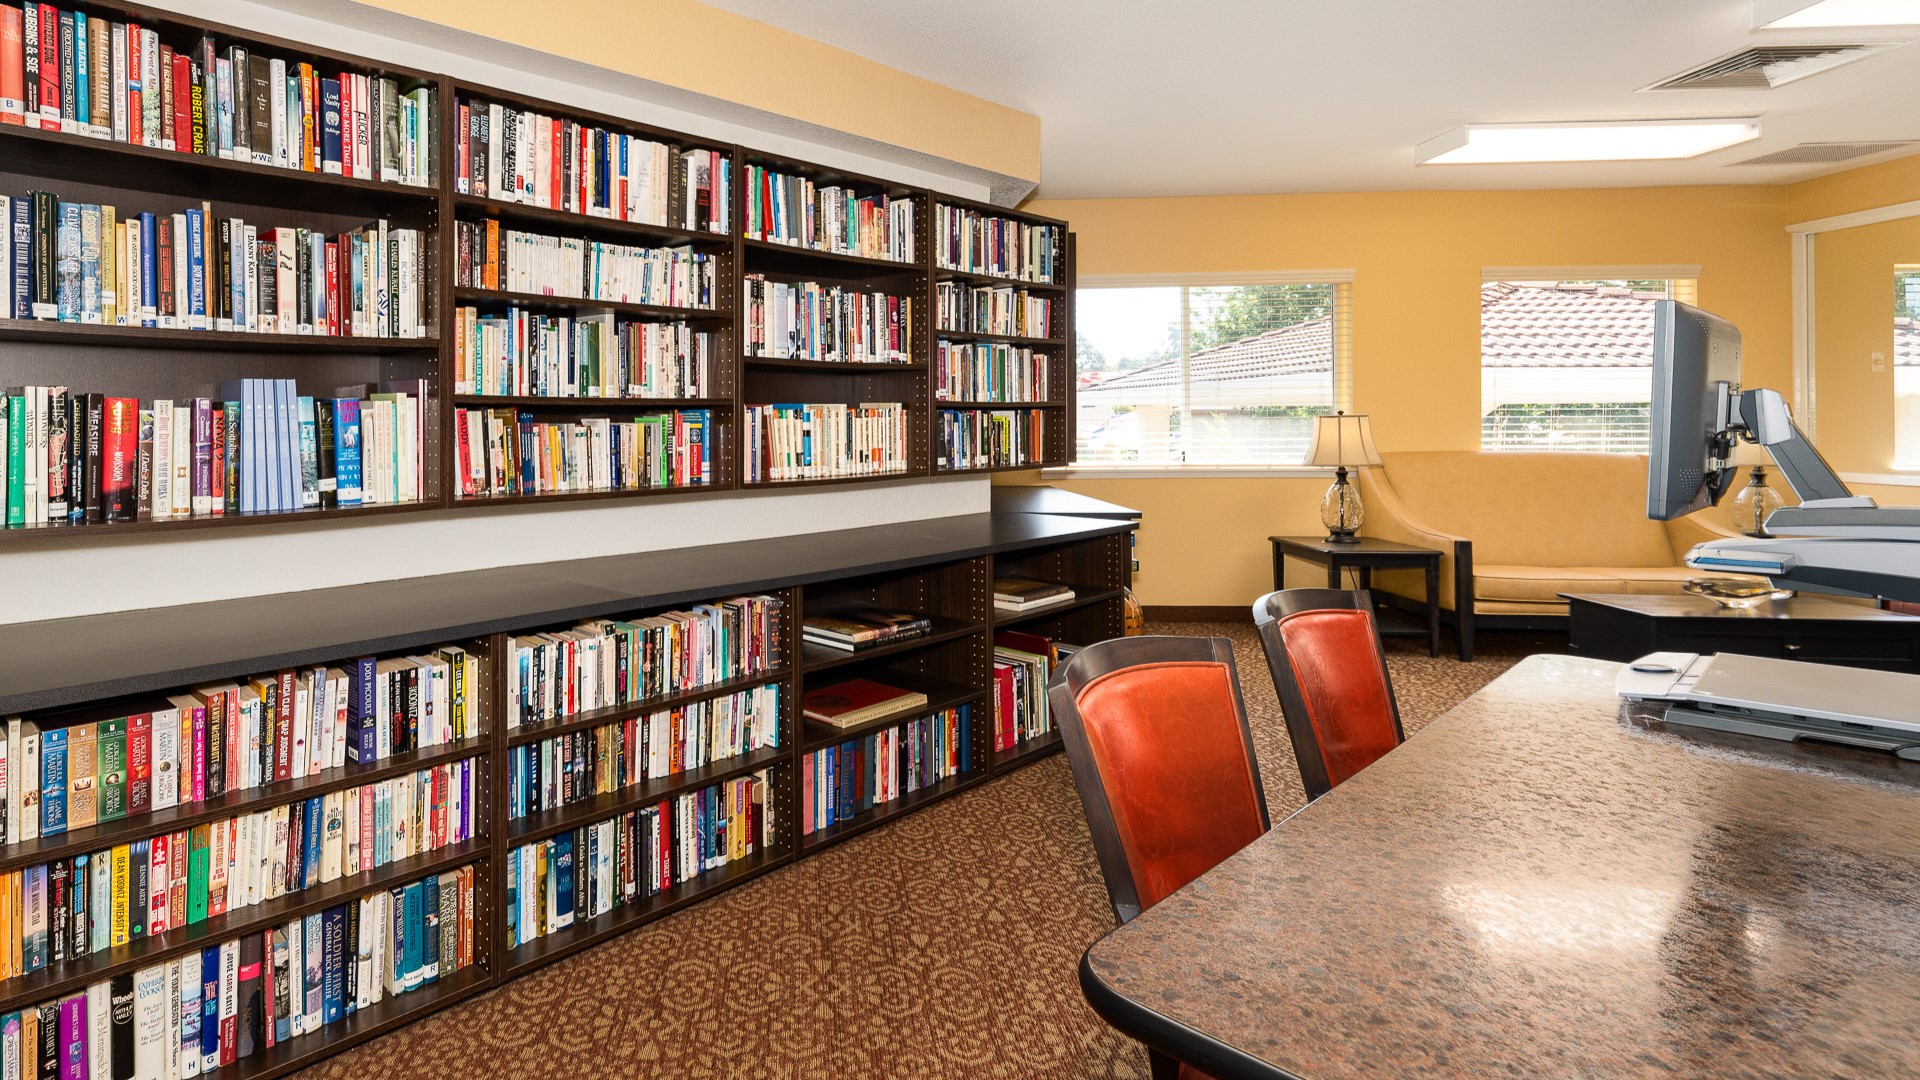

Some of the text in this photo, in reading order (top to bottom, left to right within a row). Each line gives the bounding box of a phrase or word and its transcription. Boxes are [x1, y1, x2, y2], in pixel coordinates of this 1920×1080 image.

[64, 28, 73, 57] AROUND
[78, 39, 86, 75] AVIATOR
[65, 64, 73, 89] WORLD
[6, 99, 14, 108] B
[65, 94, 73, 103] 80
[191, 85, 204, 154] ROBERT CRAIS
[342, 100, 352, 167] ONE MORE TIME!
[353, 110, 368, 146] FLICKER
[509, 109, 517, 152] BOMBER
[67, 207, 79, 273] CLIVE CUSSLER
[247, 235, 255, 260] DANNY
[89, 409, 99, 457] MEASURE
[214, 417, 223, 449] NOVA
[228, 407, 236, 458] Lisa Scottoline
[459, 413, 469, 446] DADDY
[112, 451, 124, 482] MONSOON
[363, 662, 372, 715] JODI PICOULT
[409, 688, 417, 718] KOONTZ
[282, 697, 290, 716] CLARK
[105, 743, 113, 772] MARTIN
[132, 737, 141, 766] MARTIN
[159, 733, 167, 761] MARTIN
[48, 752, 56, 784] MARTIN
[115, 856, 125, 933] DEAN KOONTZ INTENSITY
[138, 889, 146, 907] AIRTH
[441, 888, 450, 925] MARR
[325, 922, 333, 953] GENERAL
[332, 914, 342, 1002] A SOLDIER FIRST
[95, 1010, 107, 1069] The Morningside
[188, 1061, 195, 1070] H
[207, 1056, 214, 1064] G
